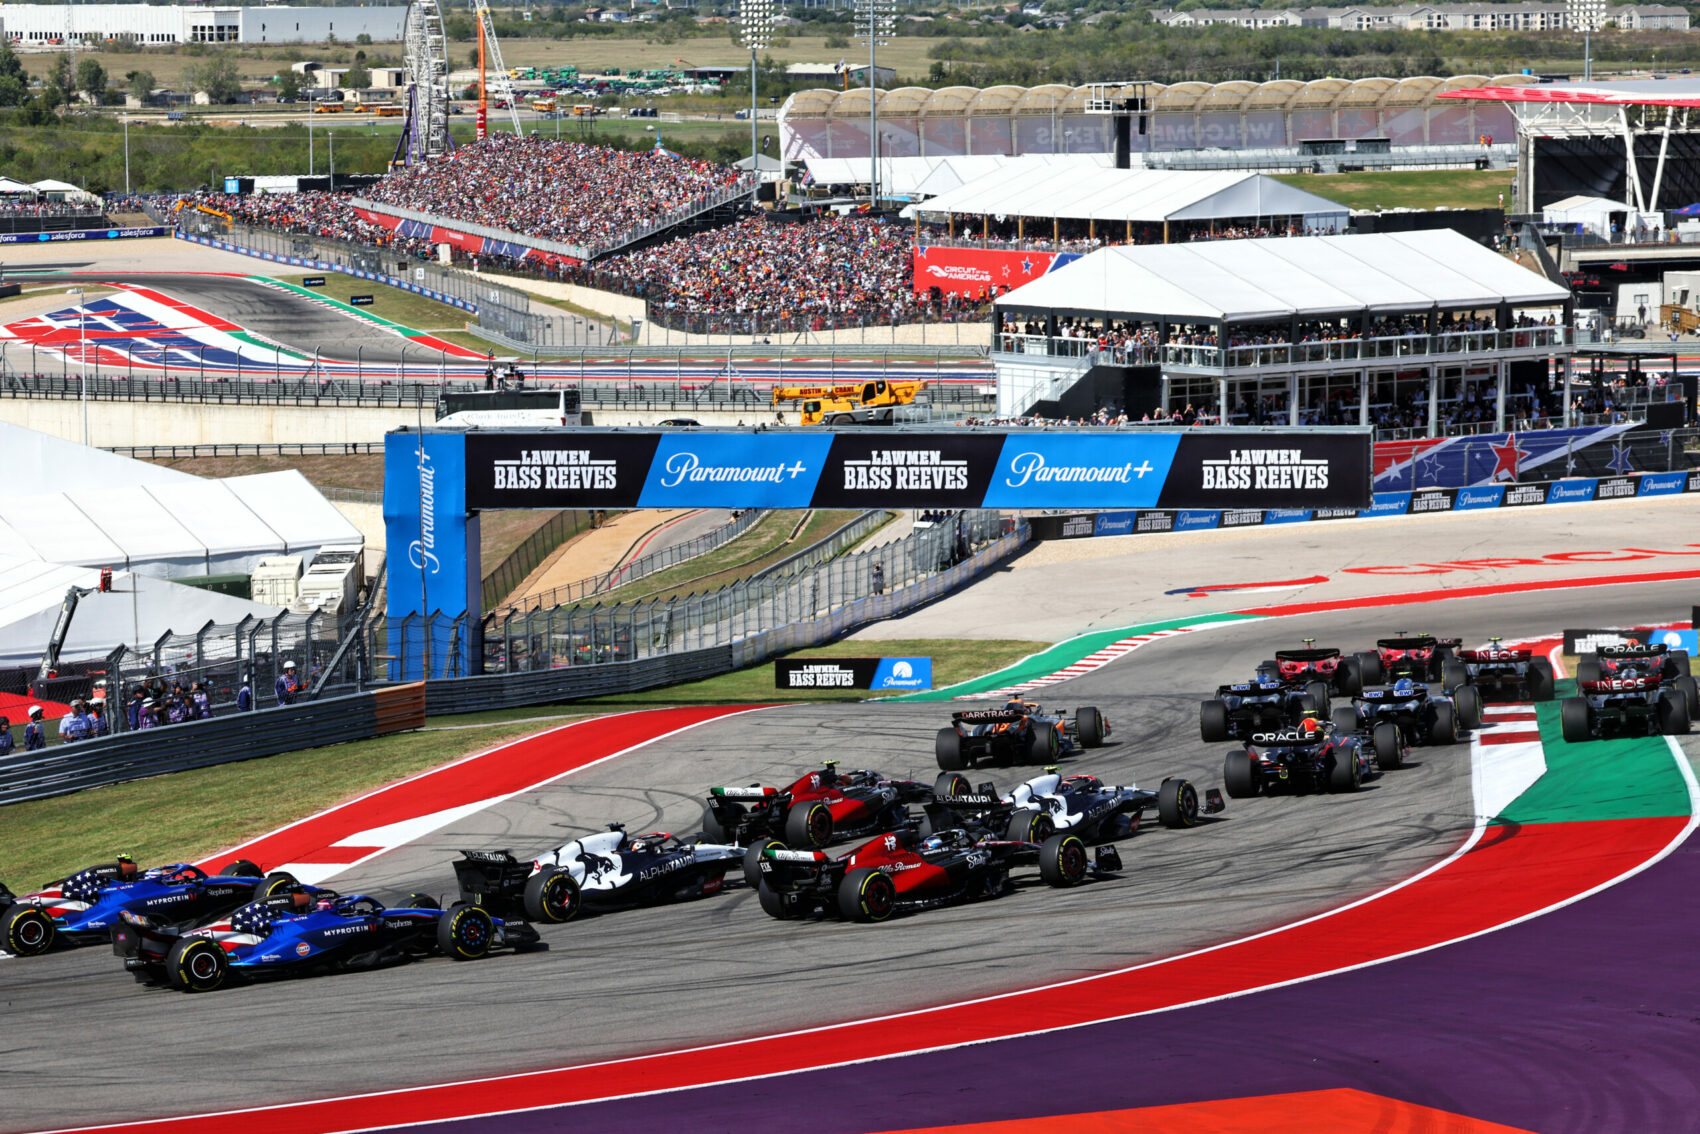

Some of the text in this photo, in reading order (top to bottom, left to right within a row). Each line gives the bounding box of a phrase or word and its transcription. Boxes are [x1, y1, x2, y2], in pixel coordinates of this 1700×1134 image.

[51, 232, 86, 241] salesforce
[120, 229, 154, 237] salesforce
[948, 273, 991, 281] AMERICAS
[800, 387, 822, 395] AUSTIN
[521, 450, 590, 465] LAWMEN
[871, 450, 941, 465] LAWMEN
[1230, 449, 1302, 465] LAWMEN
[661, 452, 807, 488] Paramount+
[1006, 452, 1154, 488] Paramount+
[494, 466, 617, 489] BASS REEVES
[844, 466, 968, 490] BASS REEVES
[1202, 466, 1329, 489] BASS REEVES
[1642, 478, 1682, 493] Paramount+
[1459, 491, 1500, 507] Paramount+
[1551, 485, 1592, 500] Paramount+
[409, 447, 440, 574] Paramount+
[1178, 512, 1217, 527] Paramount+
[1476, 650, 1519, 660] INEOS
[1604, 644, 1660, 654] ORACLE
[803, 664, 840, 673] LAWMEN
[789, 673, 854, 687] BASS REEVES
[882, 676, 922, 687] Paramount+
[1596, 678, 1646, 691] INEOS
[961, 710, 1015, 719] DARKTRACE
[1252, 731, 1315, 742] ORACLE
[640, 854, 695, 881] ALPHATAURI
[894, 861, 922, 872] Romeo
[207, 887, 233, 897] Stephens
[146, 894, 190, 906] MYPROTEIN
[324, 925, 369, 937] MYPROTEIN
[385, 920, 413, 929] Stephens
